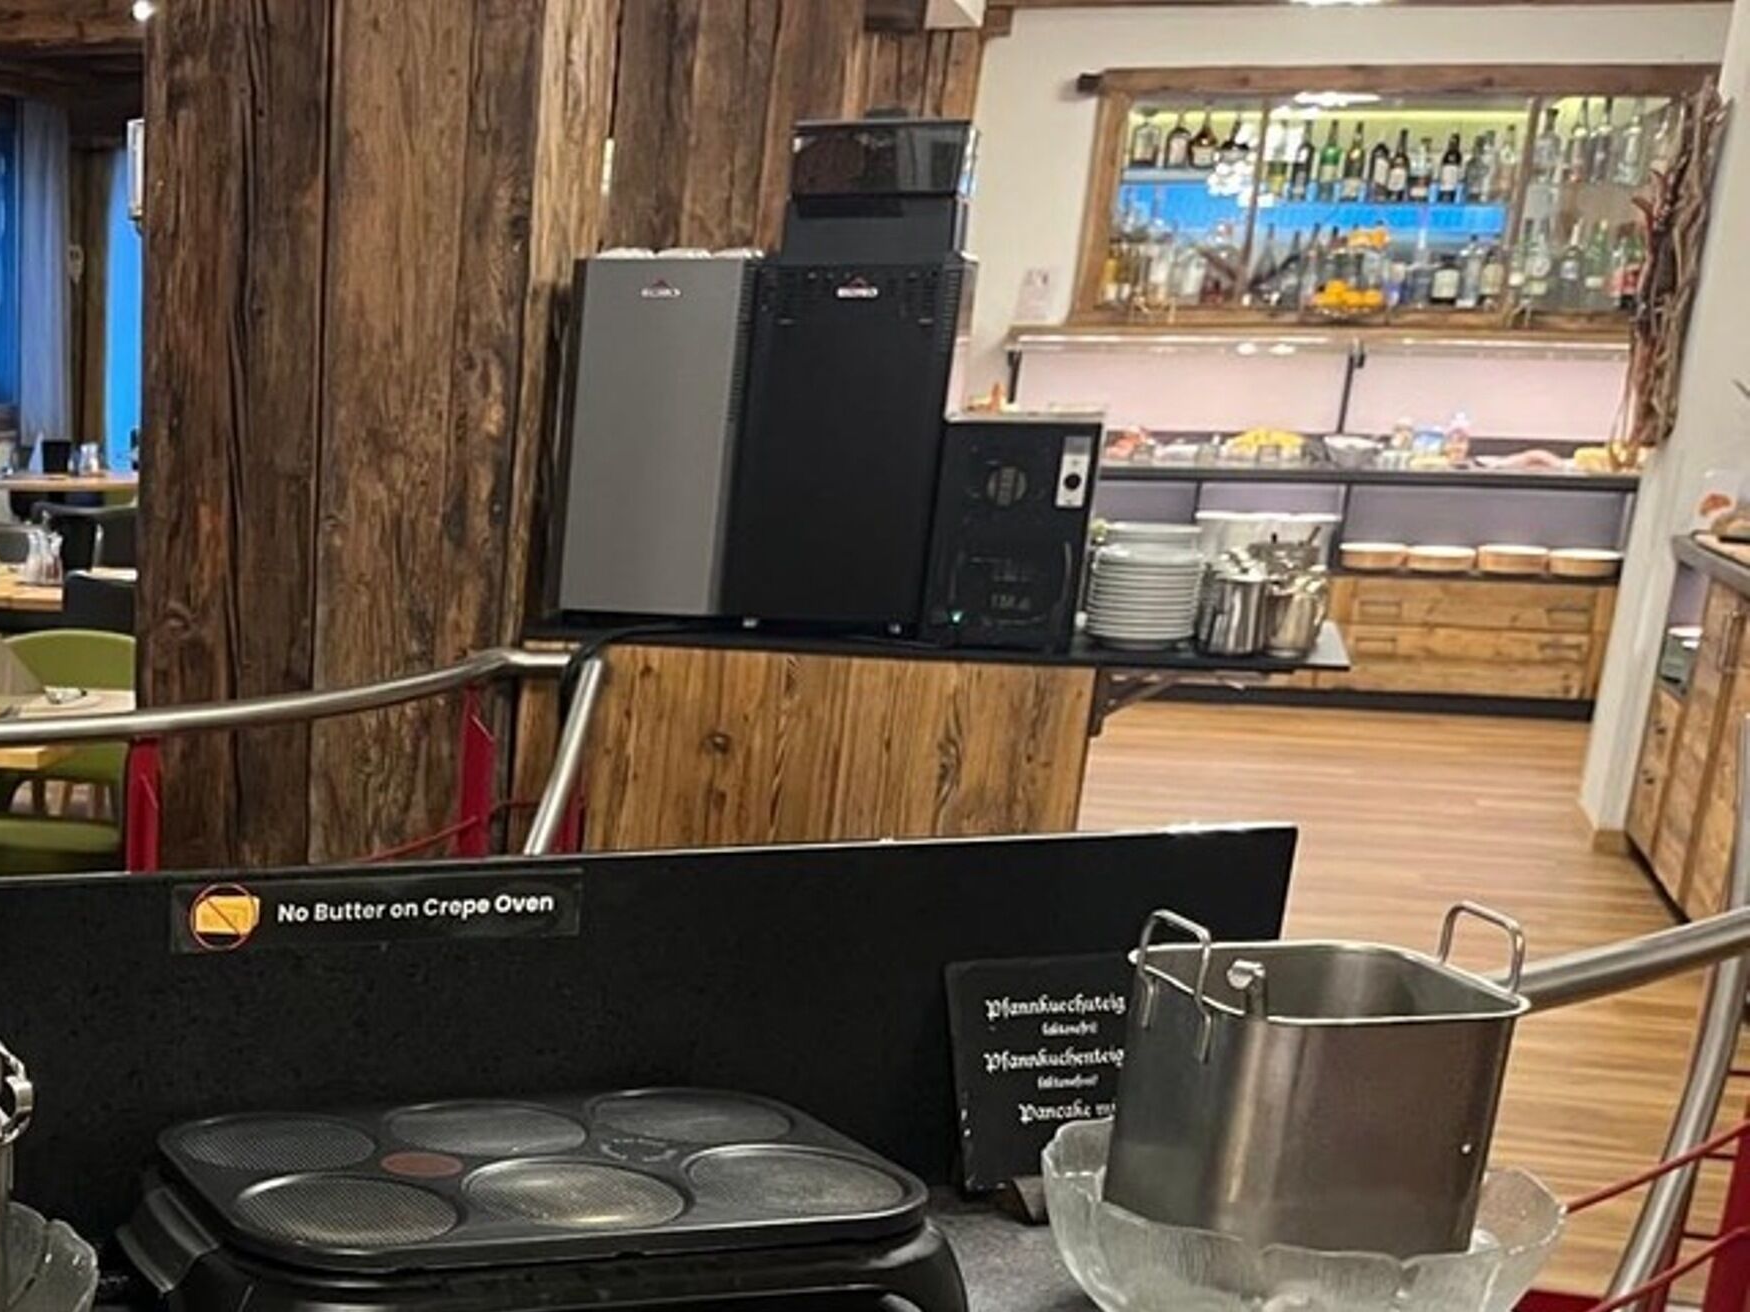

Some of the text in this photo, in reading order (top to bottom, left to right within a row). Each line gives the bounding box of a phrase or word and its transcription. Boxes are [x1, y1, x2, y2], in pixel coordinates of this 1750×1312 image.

[277, 894, 555, 923] No Butter on Crepe Oven
[1018, 1099, 1092, 1124] Pancake
